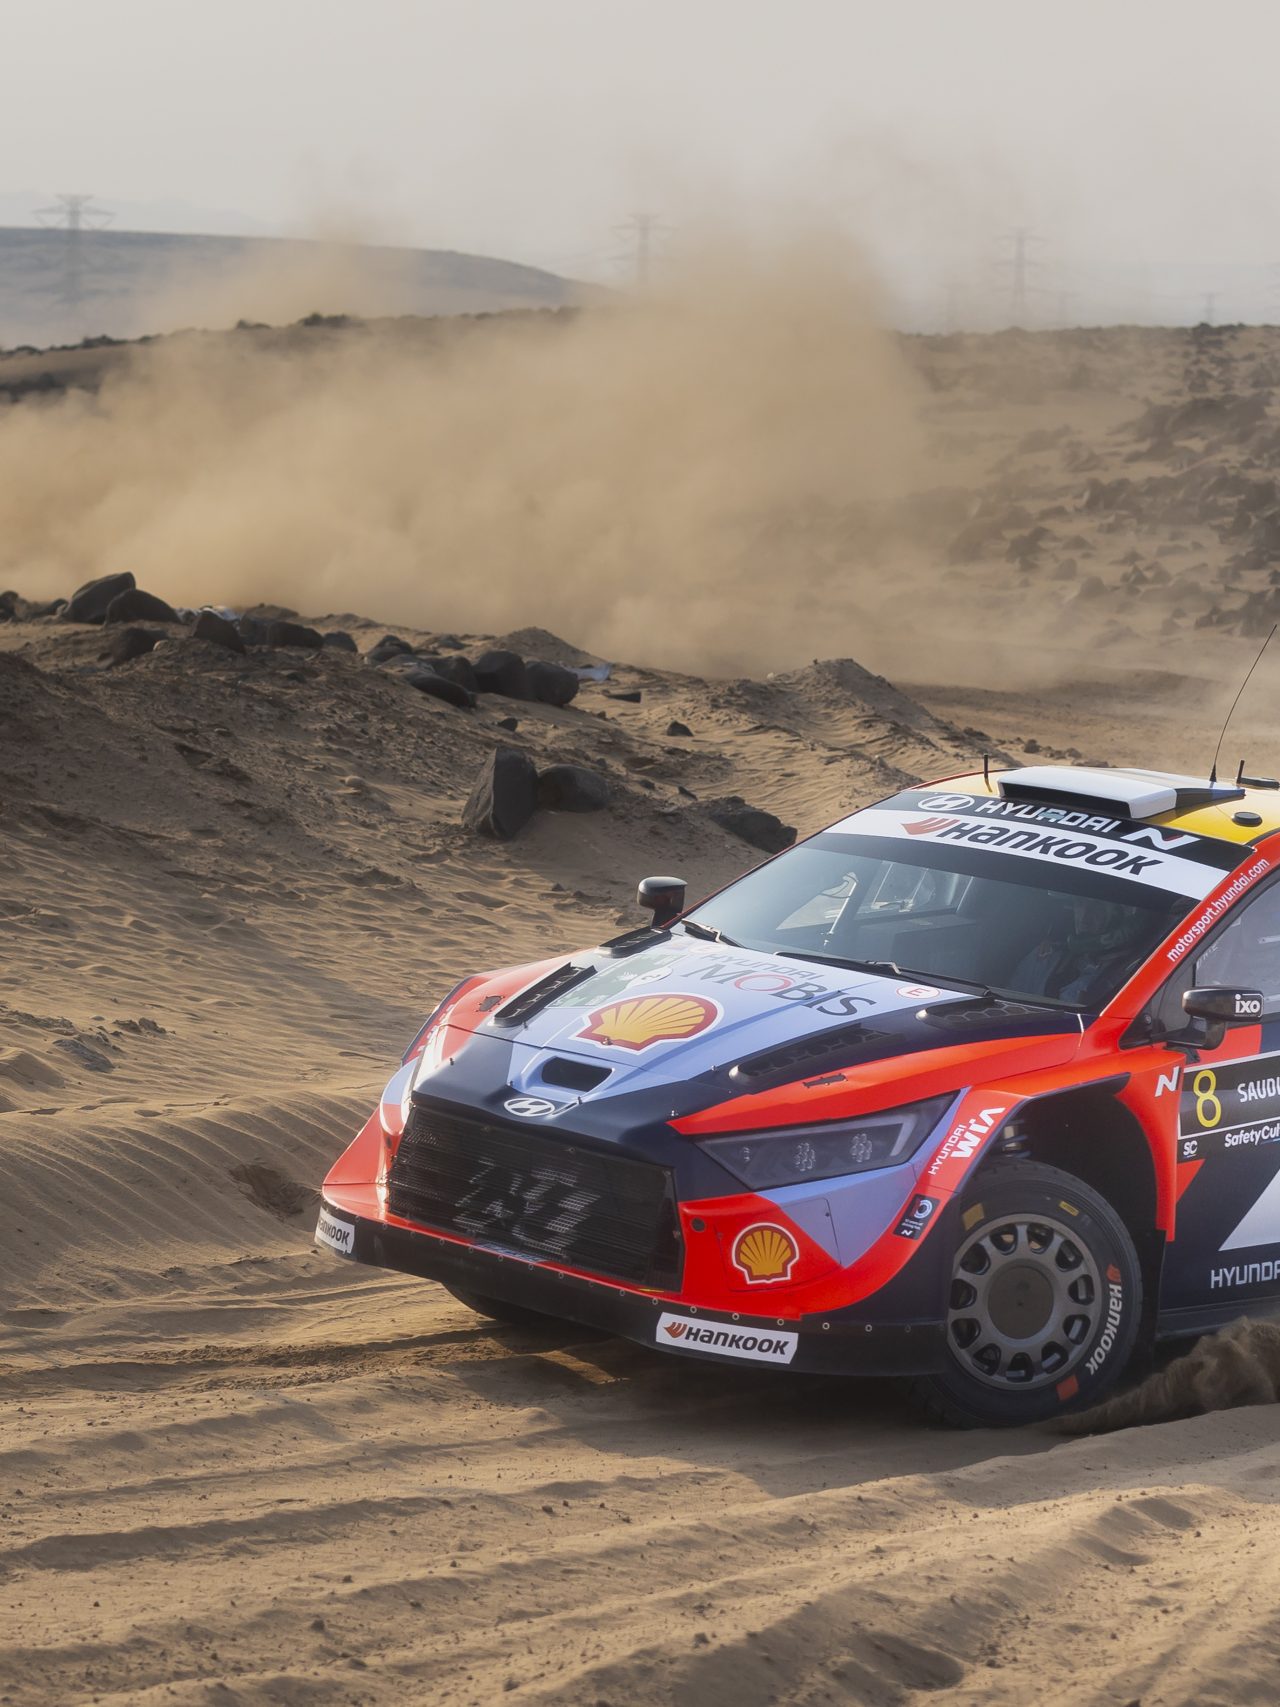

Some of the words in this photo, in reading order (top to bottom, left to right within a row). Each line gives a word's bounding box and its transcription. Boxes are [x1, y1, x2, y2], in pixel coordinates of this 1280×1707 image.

[1166, 858, 1270, 963] motorsport.hyundai.com
[680, 963, 877, 1017] MOBIS
[699, 952, 825, 980] HYUNDAI
[1192, 1069, 1222, 1129] 8
[928, 1124, 967, 1176] HYUNDAI
[950, 1107, 1006, 1158] WIA
